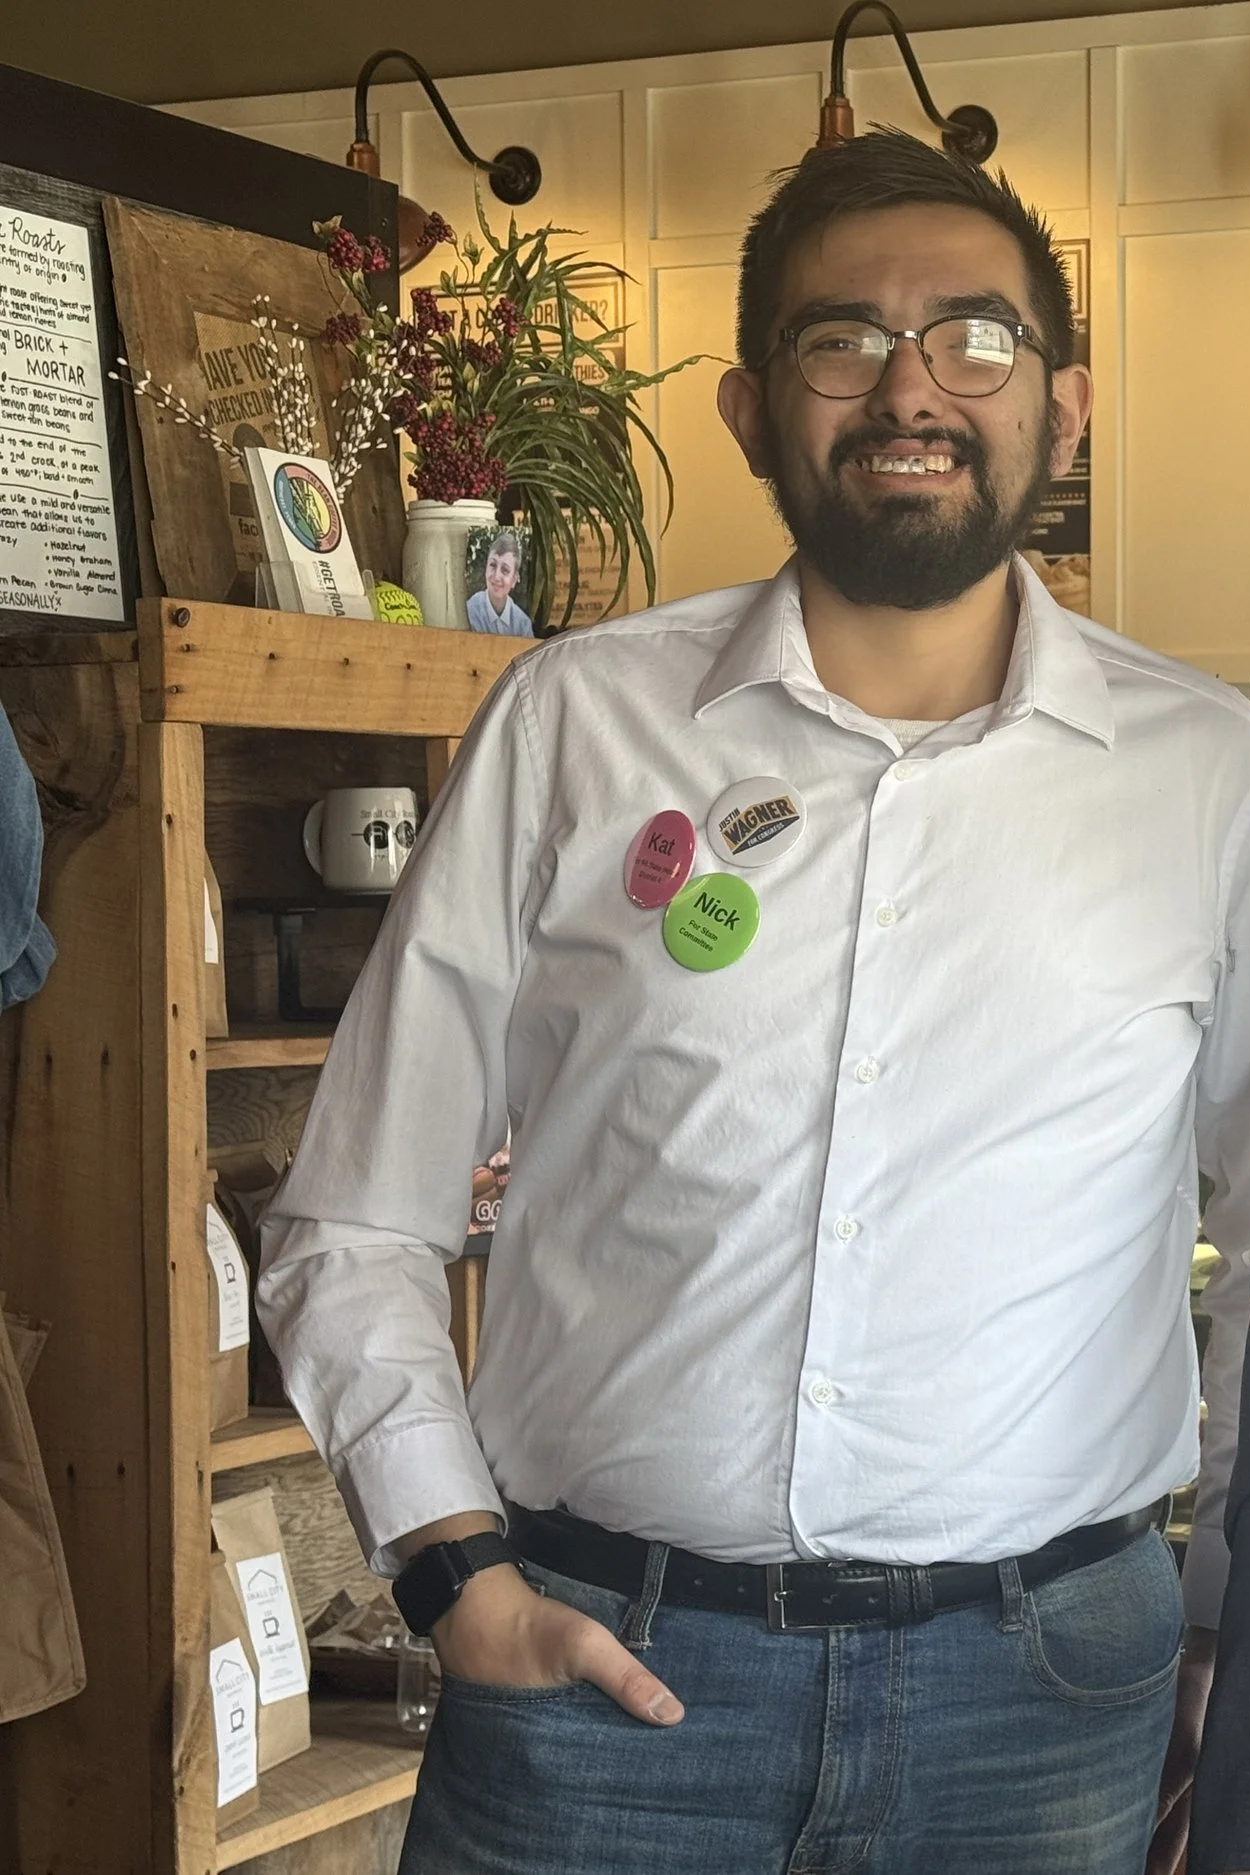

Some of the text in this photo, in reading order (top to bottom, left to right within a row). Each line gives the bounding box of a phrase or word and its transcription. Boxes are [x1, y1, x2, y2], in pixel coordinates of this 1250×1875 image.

[8, 217, 66, 255] Roasts
[36, 267, 60, 285] origin
[52, 259, 86, 281] roasting
[14, 329, 54, 354] BRICK
[27, 357, 86, 387] MORTAR
[37, 441, 54, 450] end
[722, 799, 794, 845] WAGNER
[648, 832, 675, 856] Kat
[693, 891, 740, 931] Nick
[688, 919, 701, 931] For
